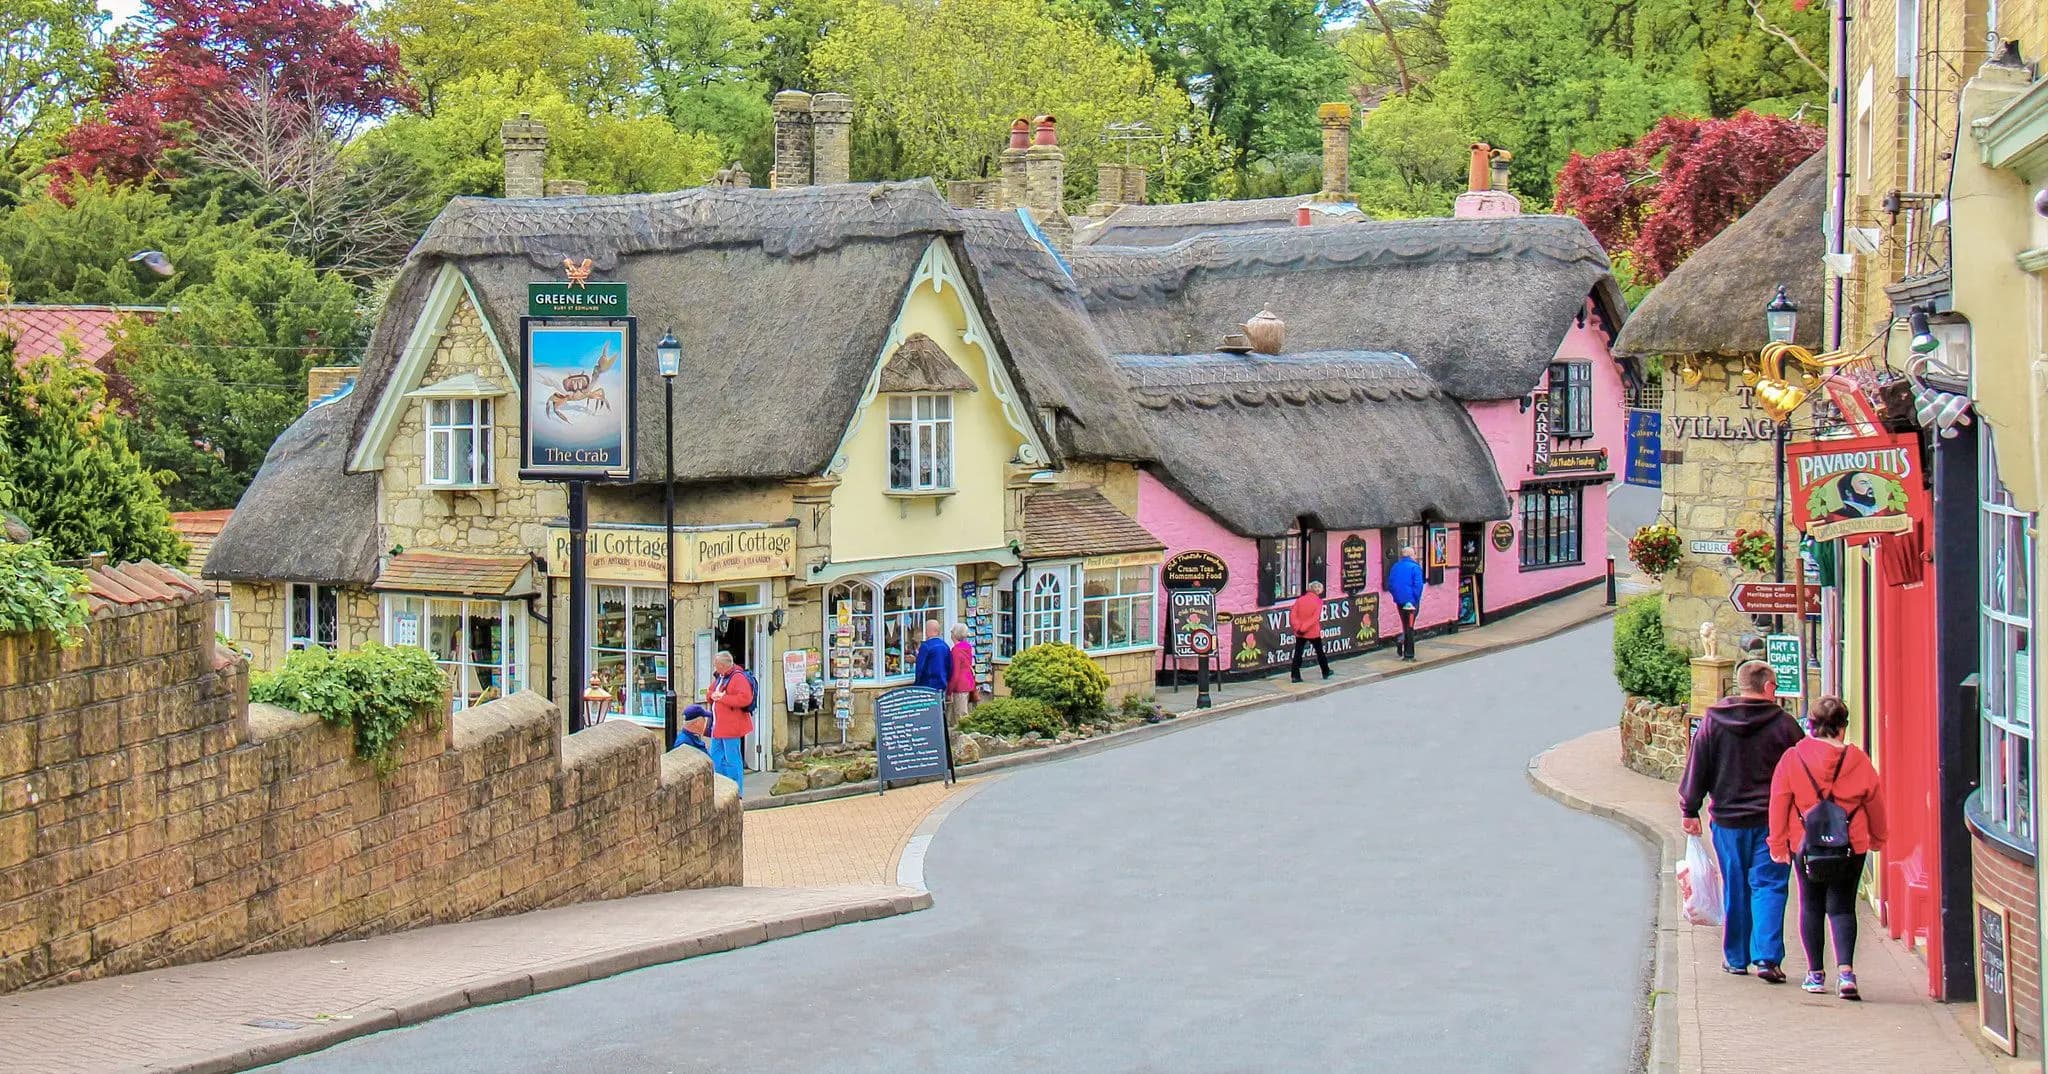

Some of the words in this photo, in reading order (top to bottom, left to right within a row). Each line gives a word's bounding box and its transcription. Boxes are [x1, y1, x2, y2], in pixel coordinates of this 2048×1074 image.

[536, 294, 582, 304] GREENE
[586, 294, 618, 305] KING
[1535, 402, 1549, 464] GARDEN
[545, 448, 572, 462] The
[575, 448, 608, 463] Crab
[1797, 447, 1912, 488] PAVAROTTI'S
[604, 533, 668, 560] Cottage
[699, 534, 733, 562] Pencil
[738, 532, 790, 556] Cottage
[647, 562, 666, 572] GARDEN
[1174, 594, 1210, 606] OPEN
[1194, 636, 1208, 646] 20
[1280, 633, 1296, 646] Bes
[1771, 642, 1788, 651] ART
[1790, 642, 1796, 651] &
[1268, 651, 1274, 664] &
[1276, 650, 1290, 662] Tea
[1771, 653, 1798, 663] CRAFT
